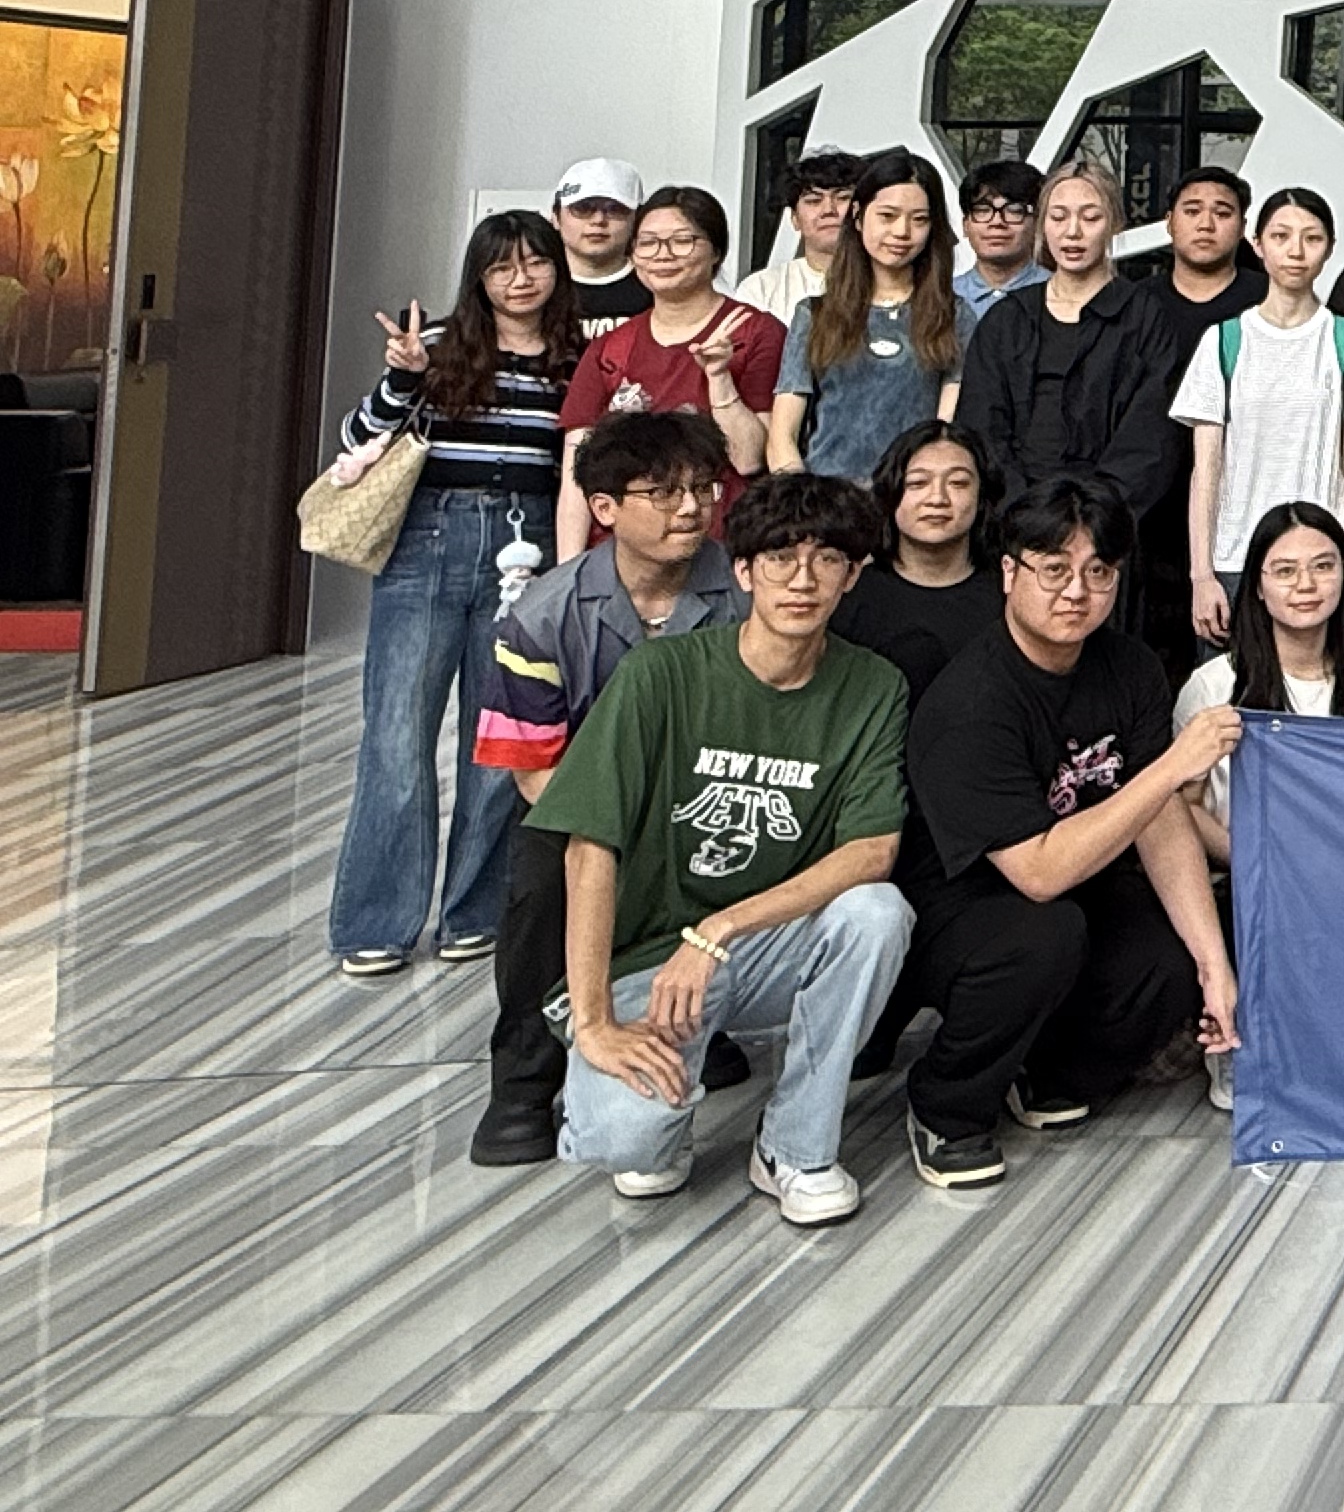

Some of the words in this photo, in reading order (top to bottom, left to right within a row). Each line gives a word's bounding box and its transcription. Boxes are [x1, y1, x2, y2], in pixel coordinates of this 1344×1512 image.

[694, 747, 753, 779] NEW
[754, 754, 820, 789] YORK
[670, 782, 802, 842] JETS
